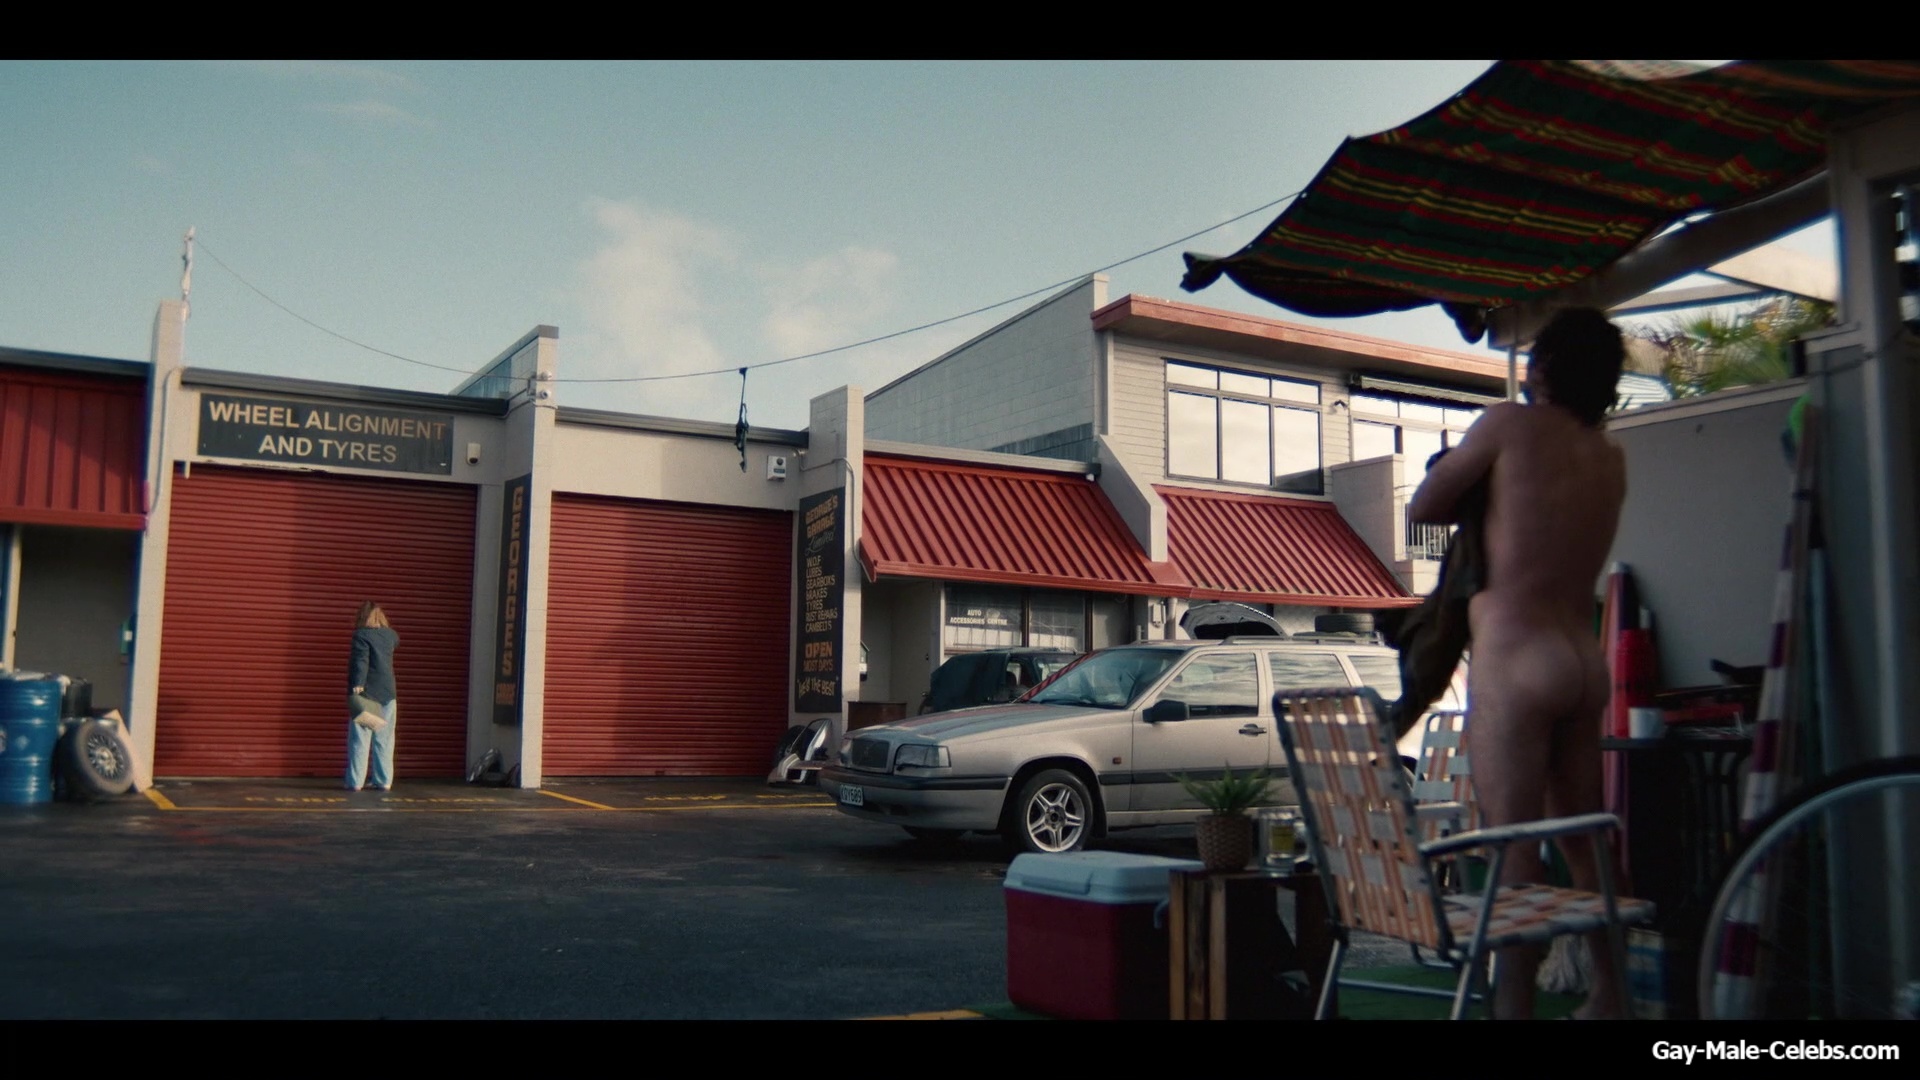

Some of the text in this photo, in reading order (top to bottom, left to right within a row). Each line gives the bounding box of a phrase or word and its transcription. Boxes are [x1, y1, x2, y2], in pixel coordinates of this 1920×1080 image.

[209, 401, 446, 440] WHEEL ALIGNMENT
[259, 434, 397, 463] AND TYRES
[806, 599, 823, 612] TYRES
[950, 616, 985, 625] ACCESSORIES
[805, 641, 833, 658] OPEN
[803, 658, 834, 672] MOST DAYS
